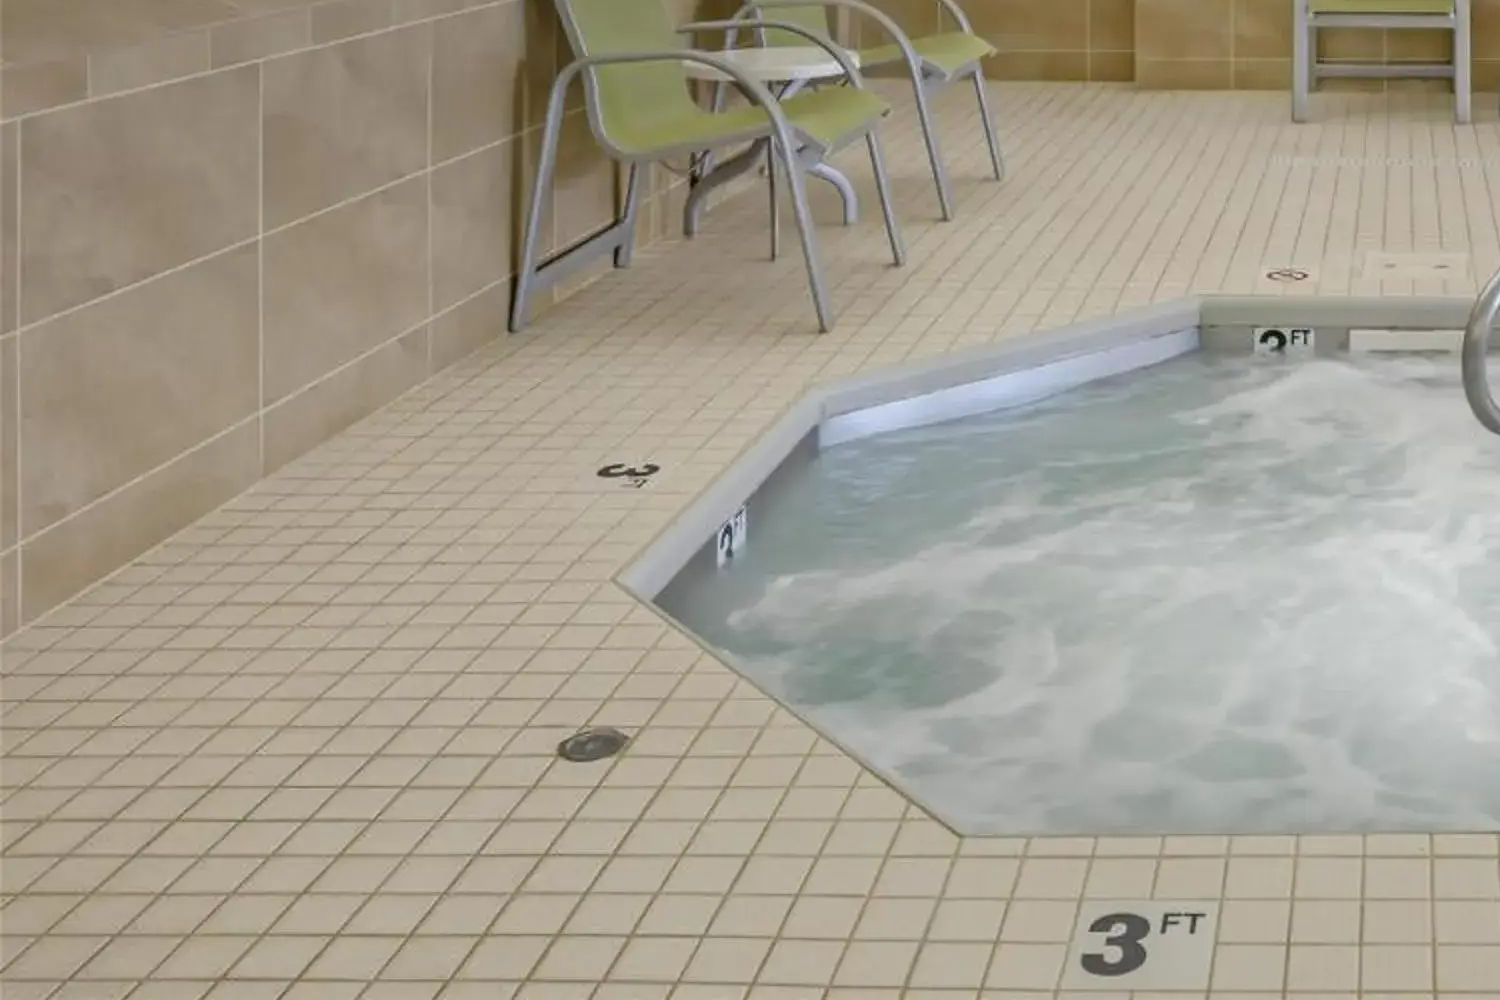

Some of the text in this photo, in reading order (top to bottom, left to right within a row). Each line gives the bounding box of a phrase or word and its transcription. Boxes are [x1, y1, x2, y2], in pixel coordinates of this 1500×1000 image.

[1291, 329, 1311, 345] FT
[596, 463, 661, 478] 3
[1080, 912, 1207, 977] 3 FT
